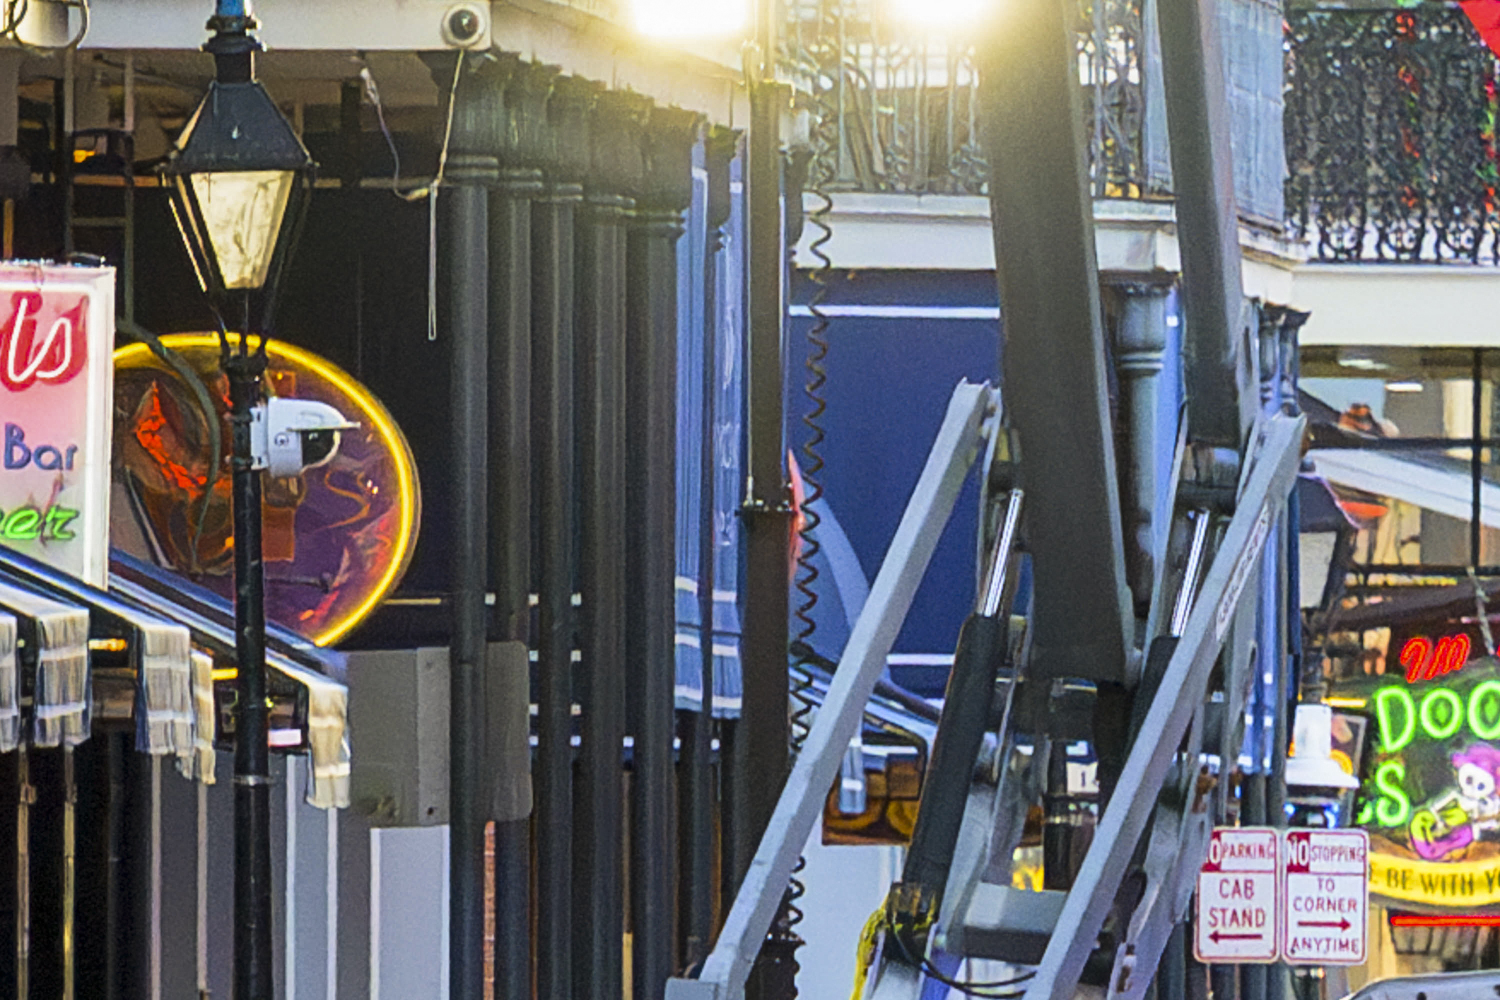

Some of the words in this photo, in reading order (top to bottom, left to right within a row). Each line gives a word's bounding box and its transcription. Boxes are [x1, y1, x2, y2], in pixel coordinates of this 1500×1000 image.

[4, 422, 78, 471] Bar
[1205, 838, 1221, 864] O
[1221, 843, 1275, 860] PARKING
[1288, 839, 1309, 866] NO
[1311, 845, 1365, 863] STOPPING
[1219, 878, 1255, 900] CAB
[1316, 877, 1336, 893] TO
[1420, 872, 1475, 897] WITH
[1293, 897, 1358, 913] CORNER
[1208, 907, 1267, 928] STAND
[1291, 937, 1359, 953] ANYTIME
